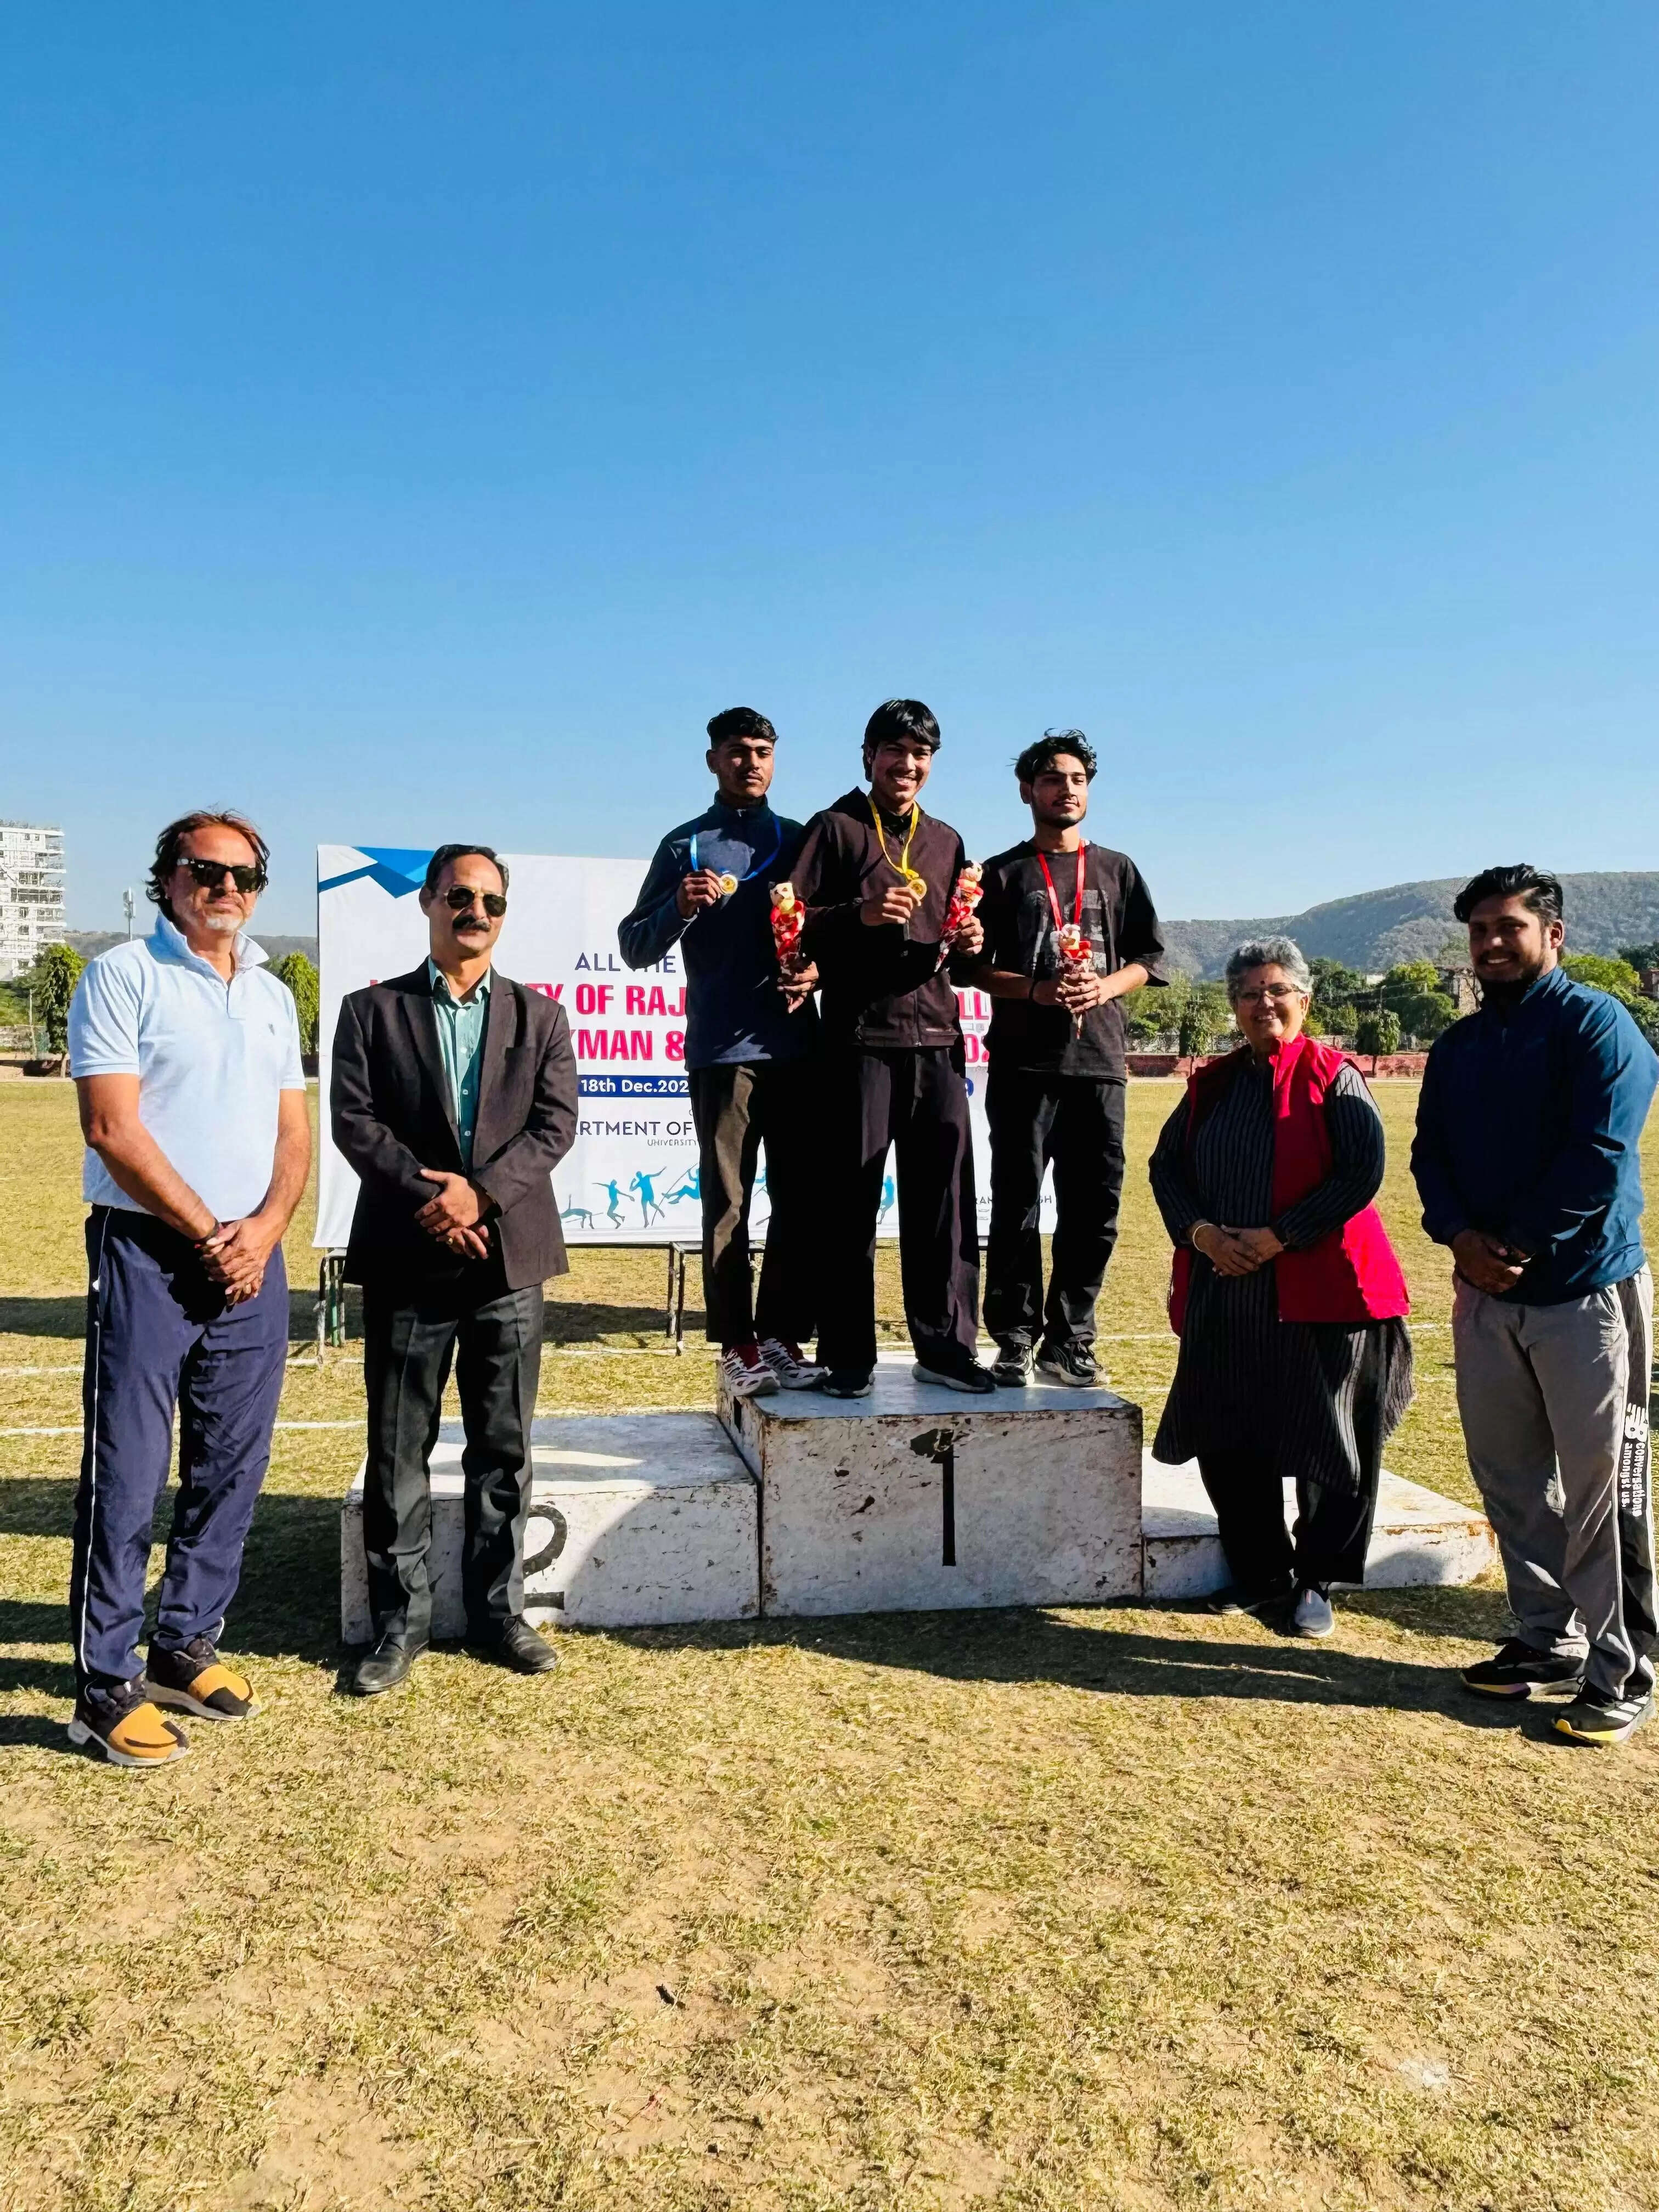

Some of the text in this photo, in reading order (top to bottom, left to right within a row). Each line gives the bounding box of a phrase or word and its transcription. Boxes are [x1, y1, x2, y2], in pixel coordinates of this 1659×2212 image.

[575, 952, 620, 972] ALL
[576, 984, 614, 1015] OF
[571, 1029, 685, 1061] MAN &
[581, 1077, 616, 1092] 18th
[575, 1121, 693, 1136] RTMENT OF
